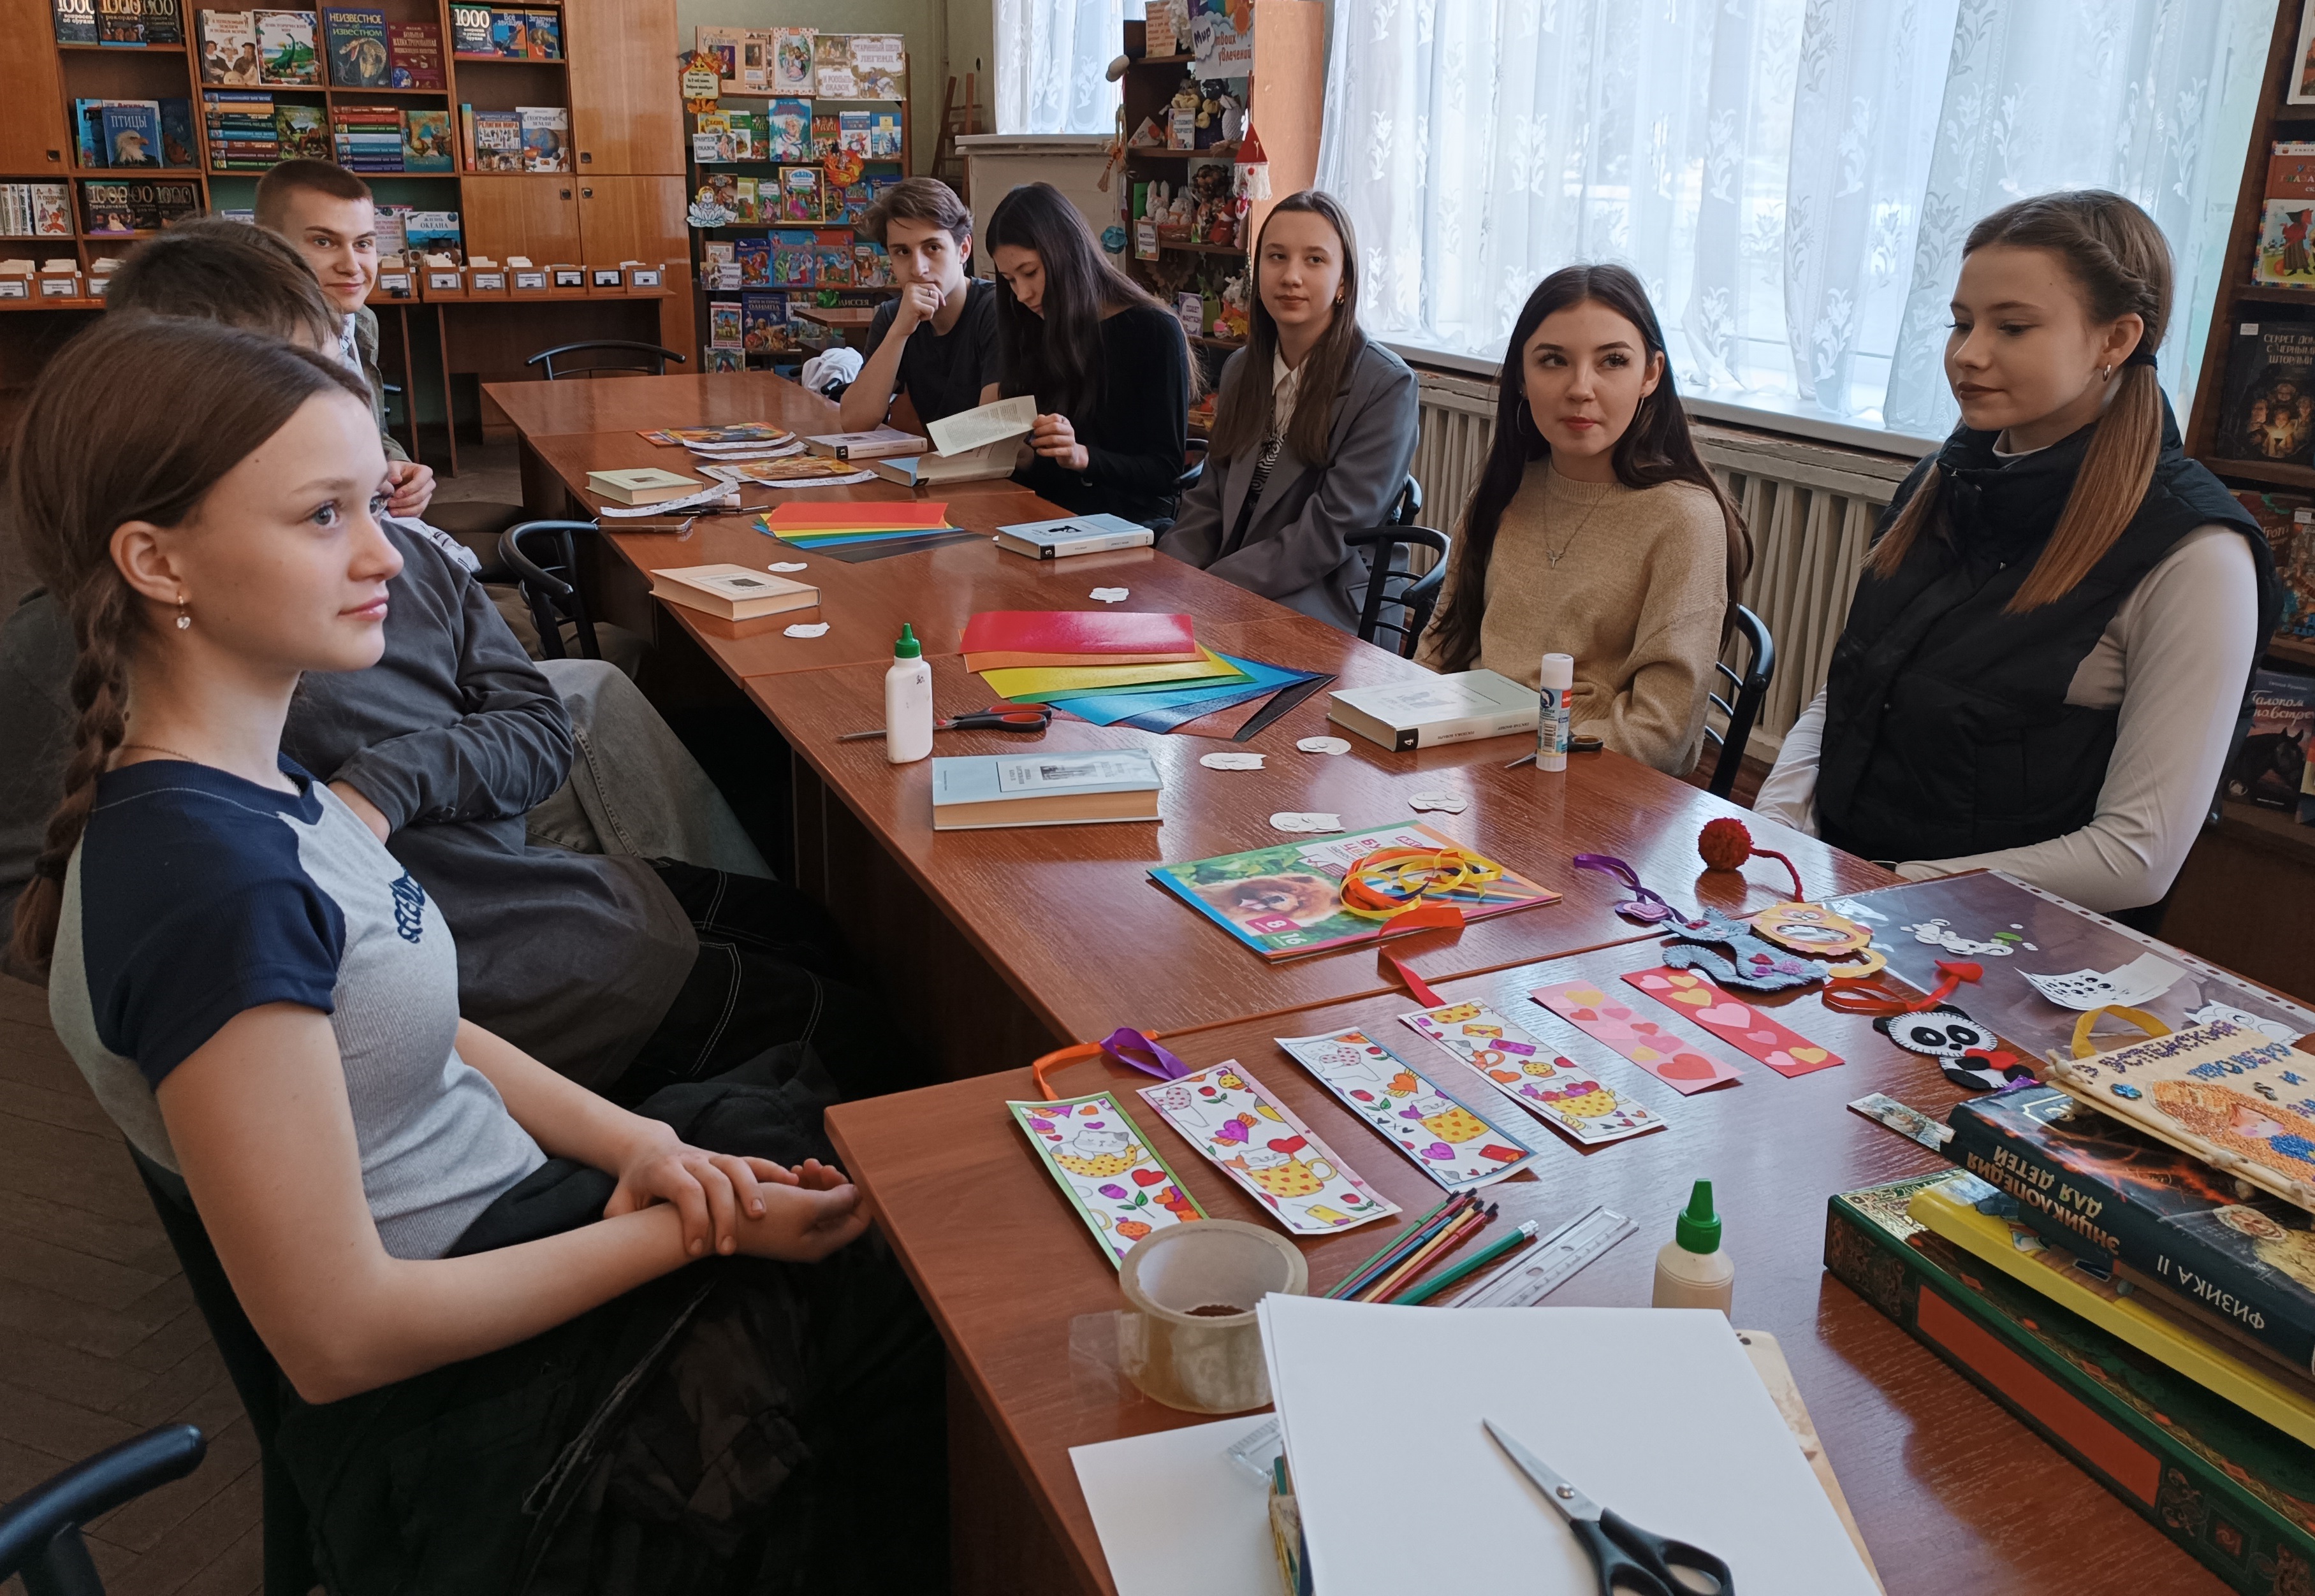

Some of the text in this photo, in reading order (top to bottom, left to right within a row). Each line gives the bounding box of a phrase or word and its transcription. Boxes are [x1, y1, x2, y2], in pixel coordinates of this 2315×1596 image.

[330, 13, 383, 24] НЕИЗВЕСТНОЕ
[455, 8, 490, 28] 1000
[1194, 27, 1211, 48] Мир
[1215, 31, 1236, 46] твоих
[1218, 45, 1252, 66] увлечений
[110, 115, 147, 130] ПТИЦЫ
[89, 185, 128, 204] 1000
[2251, 690, 2304, 707] Галопом
[1266, 920, 1287, 928] 8
[1280, 932, 1308, 945] 16
[1994, 1145, 2103, 1219] ДЛЯ ДЕТЕЙ
[1966, 1150, 2120, 1256] ЭНЦИКЛОПЕДИЯ
[2157, 1254, 2266, 1331] ФИЗИКА II
